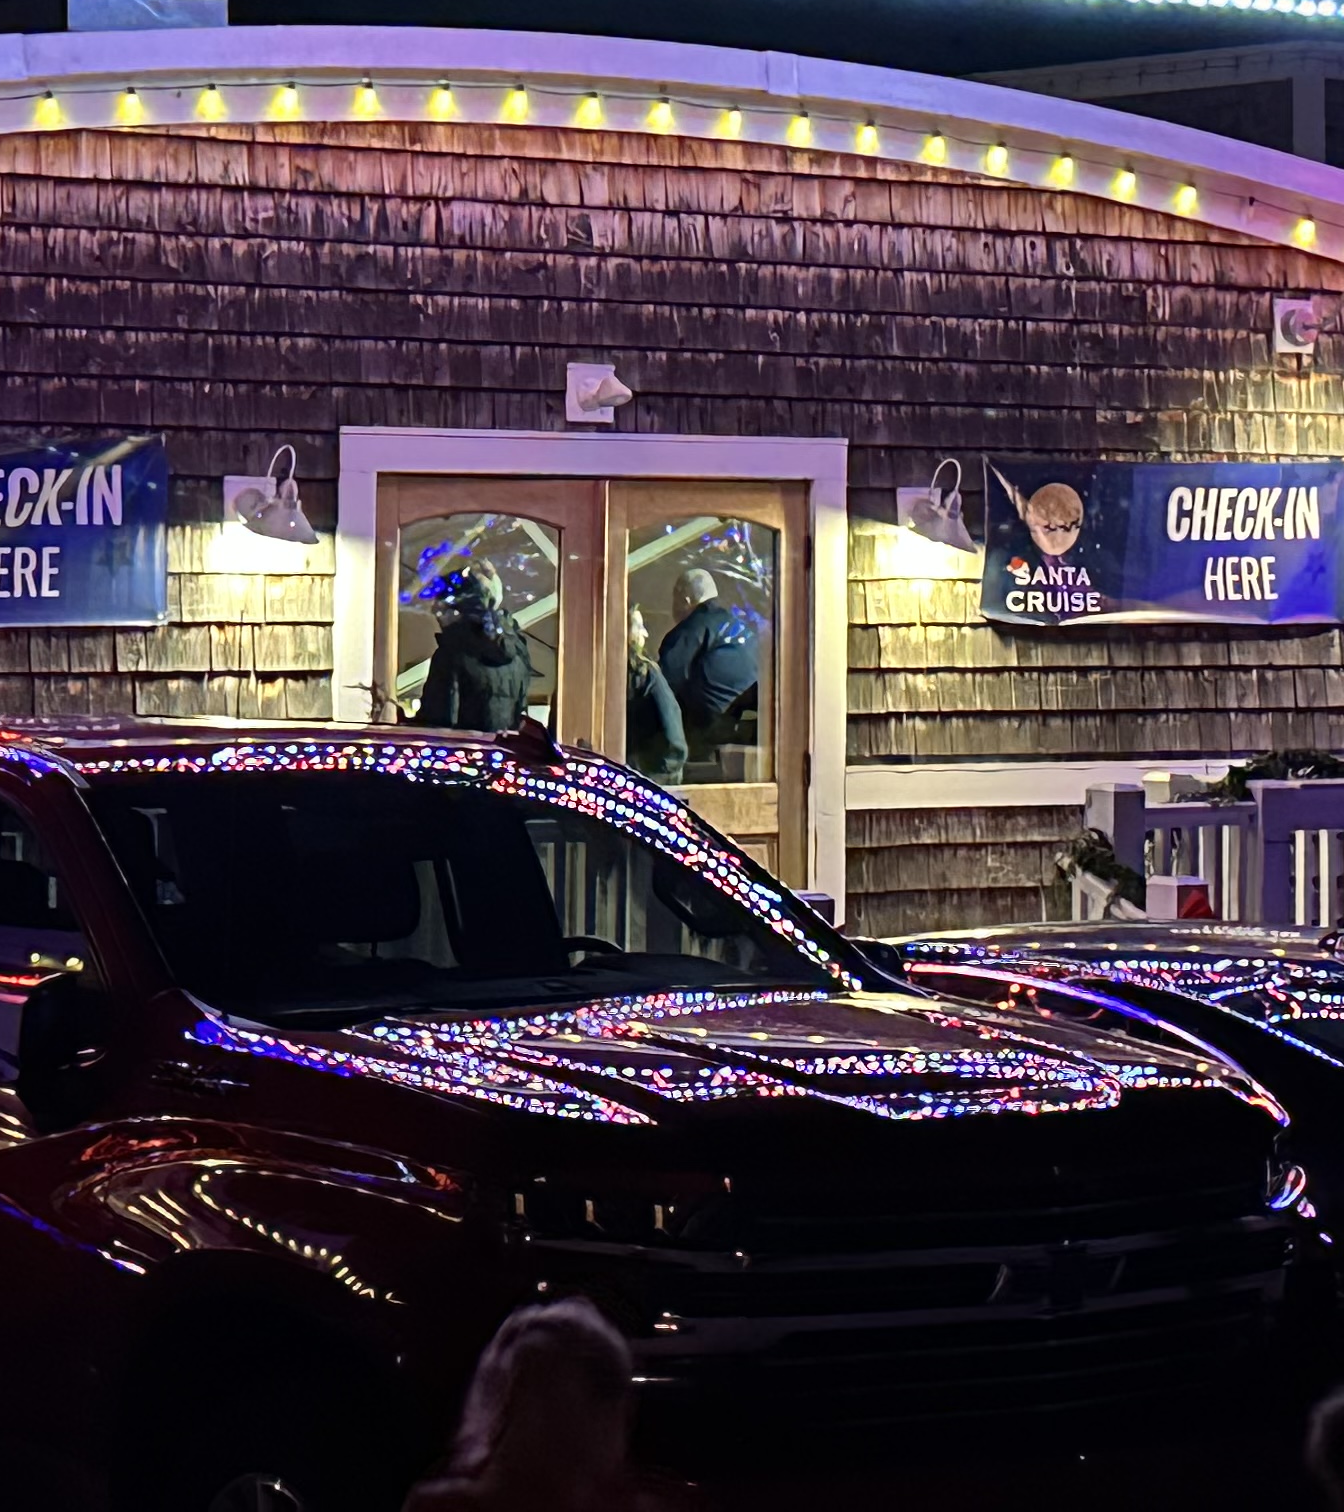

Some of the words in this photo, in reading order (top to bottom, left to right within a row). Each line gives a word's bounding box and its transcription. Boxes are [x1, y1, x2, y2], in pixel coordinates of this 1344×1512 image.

[1166, 486, 1320, 542] CHECK-IN
[1013, 565, 1092, 586] SANTA
[1203, 556, 1279, 601] HERE
[1005, 586, 1102, 613] CRUISE
